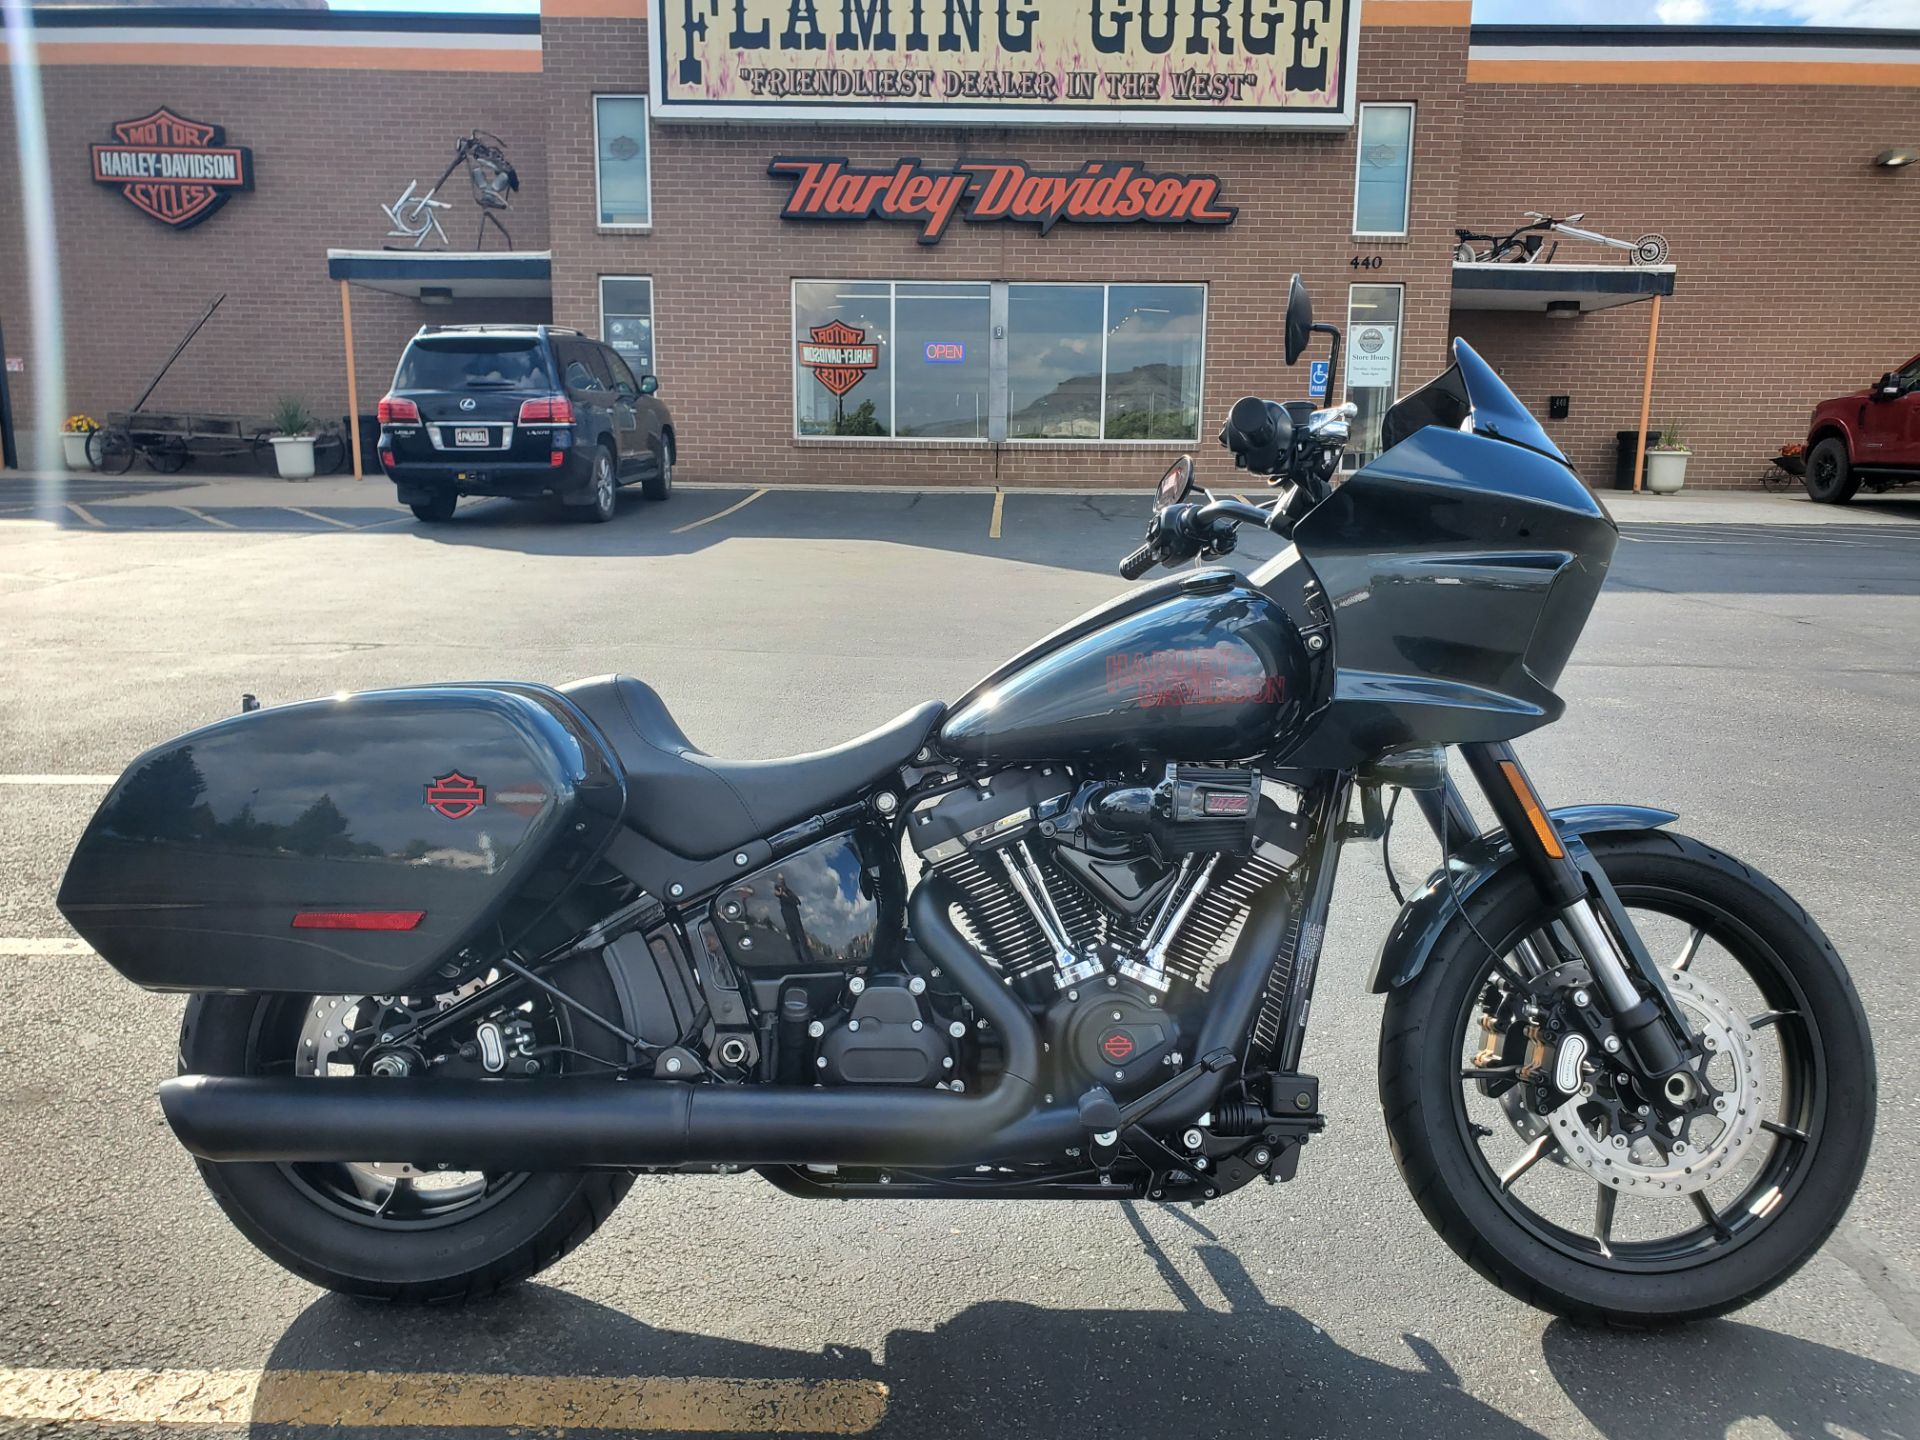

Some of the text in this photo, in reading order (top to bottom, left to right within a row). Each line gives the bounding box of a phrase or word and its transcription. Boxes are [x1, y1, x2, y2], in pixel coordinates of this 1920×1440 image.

[680, 0, 1331, 92] FLAMING GORGE
[944, 69, 1058, 101] DEALER
[1066, 70, 1097, 100] IN
[1105, 71, 1161, 100] THE
[129, 116, 201, 145] MOTOR
[100, 151, 236, 179] HARLEY-DAVIDSON
[135, 184, 205, 217] CYCLES
[772, 160, 1234, 237] Harley-Davidson
[1350, 255, 1383, 270] 440
[926, 343, 963, 360] OPEN
